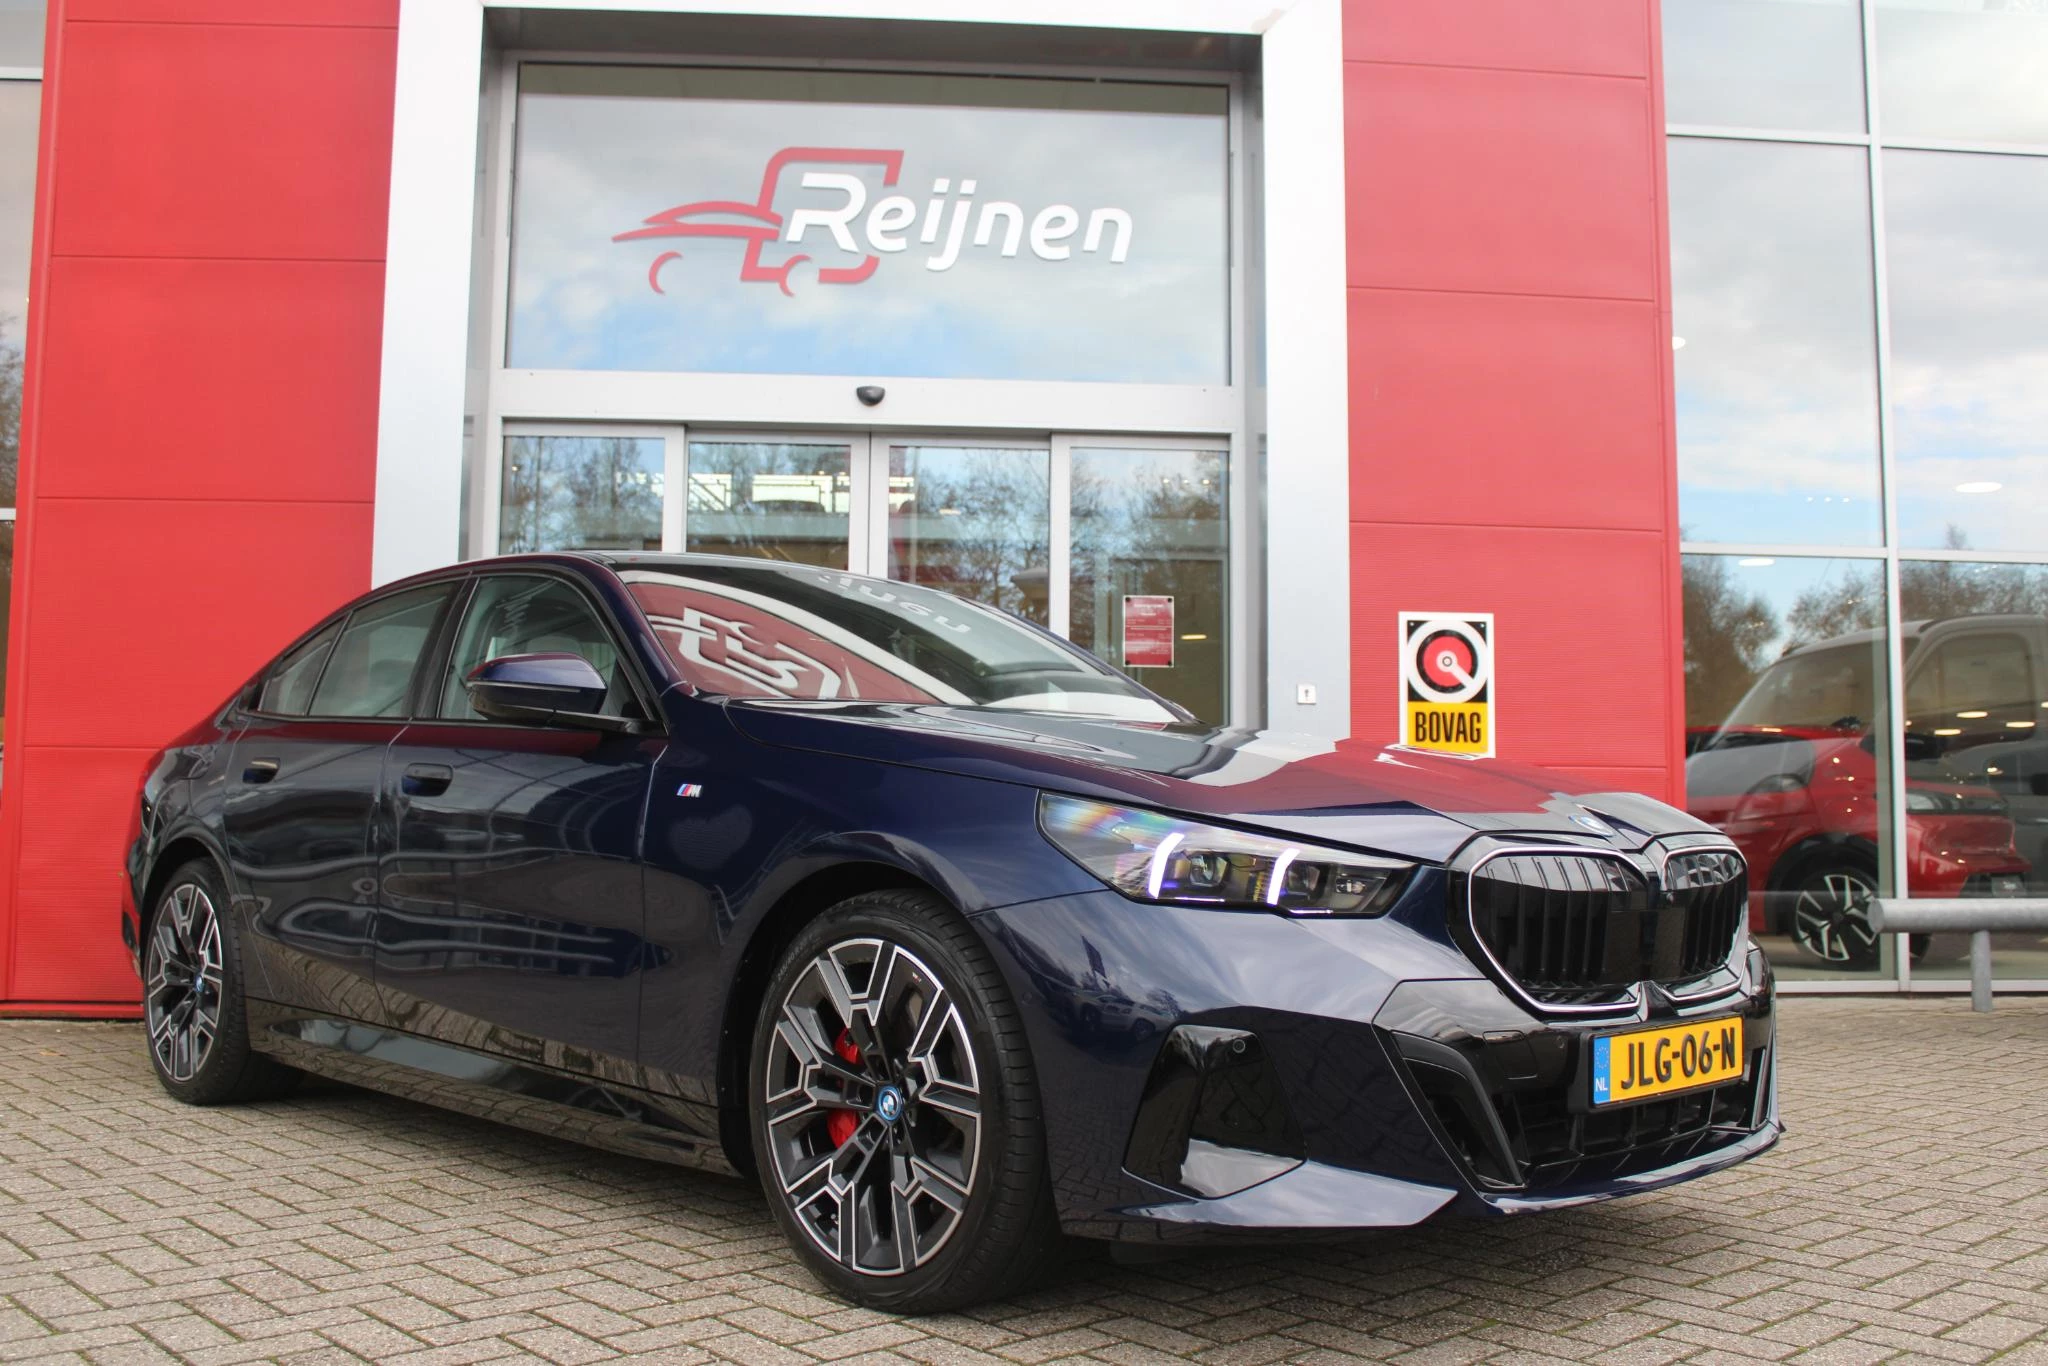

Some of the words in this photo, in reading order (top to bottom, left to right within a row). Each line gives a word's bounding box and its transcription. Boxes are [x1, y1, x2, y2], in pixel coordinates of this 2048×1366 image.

[785, 171, 1133, 272] Reijnen
[1415, 711, 1482, 743] BOVAG
[1620, 1026, 1736, 1091] JLG-06-N
[1595, 1077, 1608, 1092] NL
